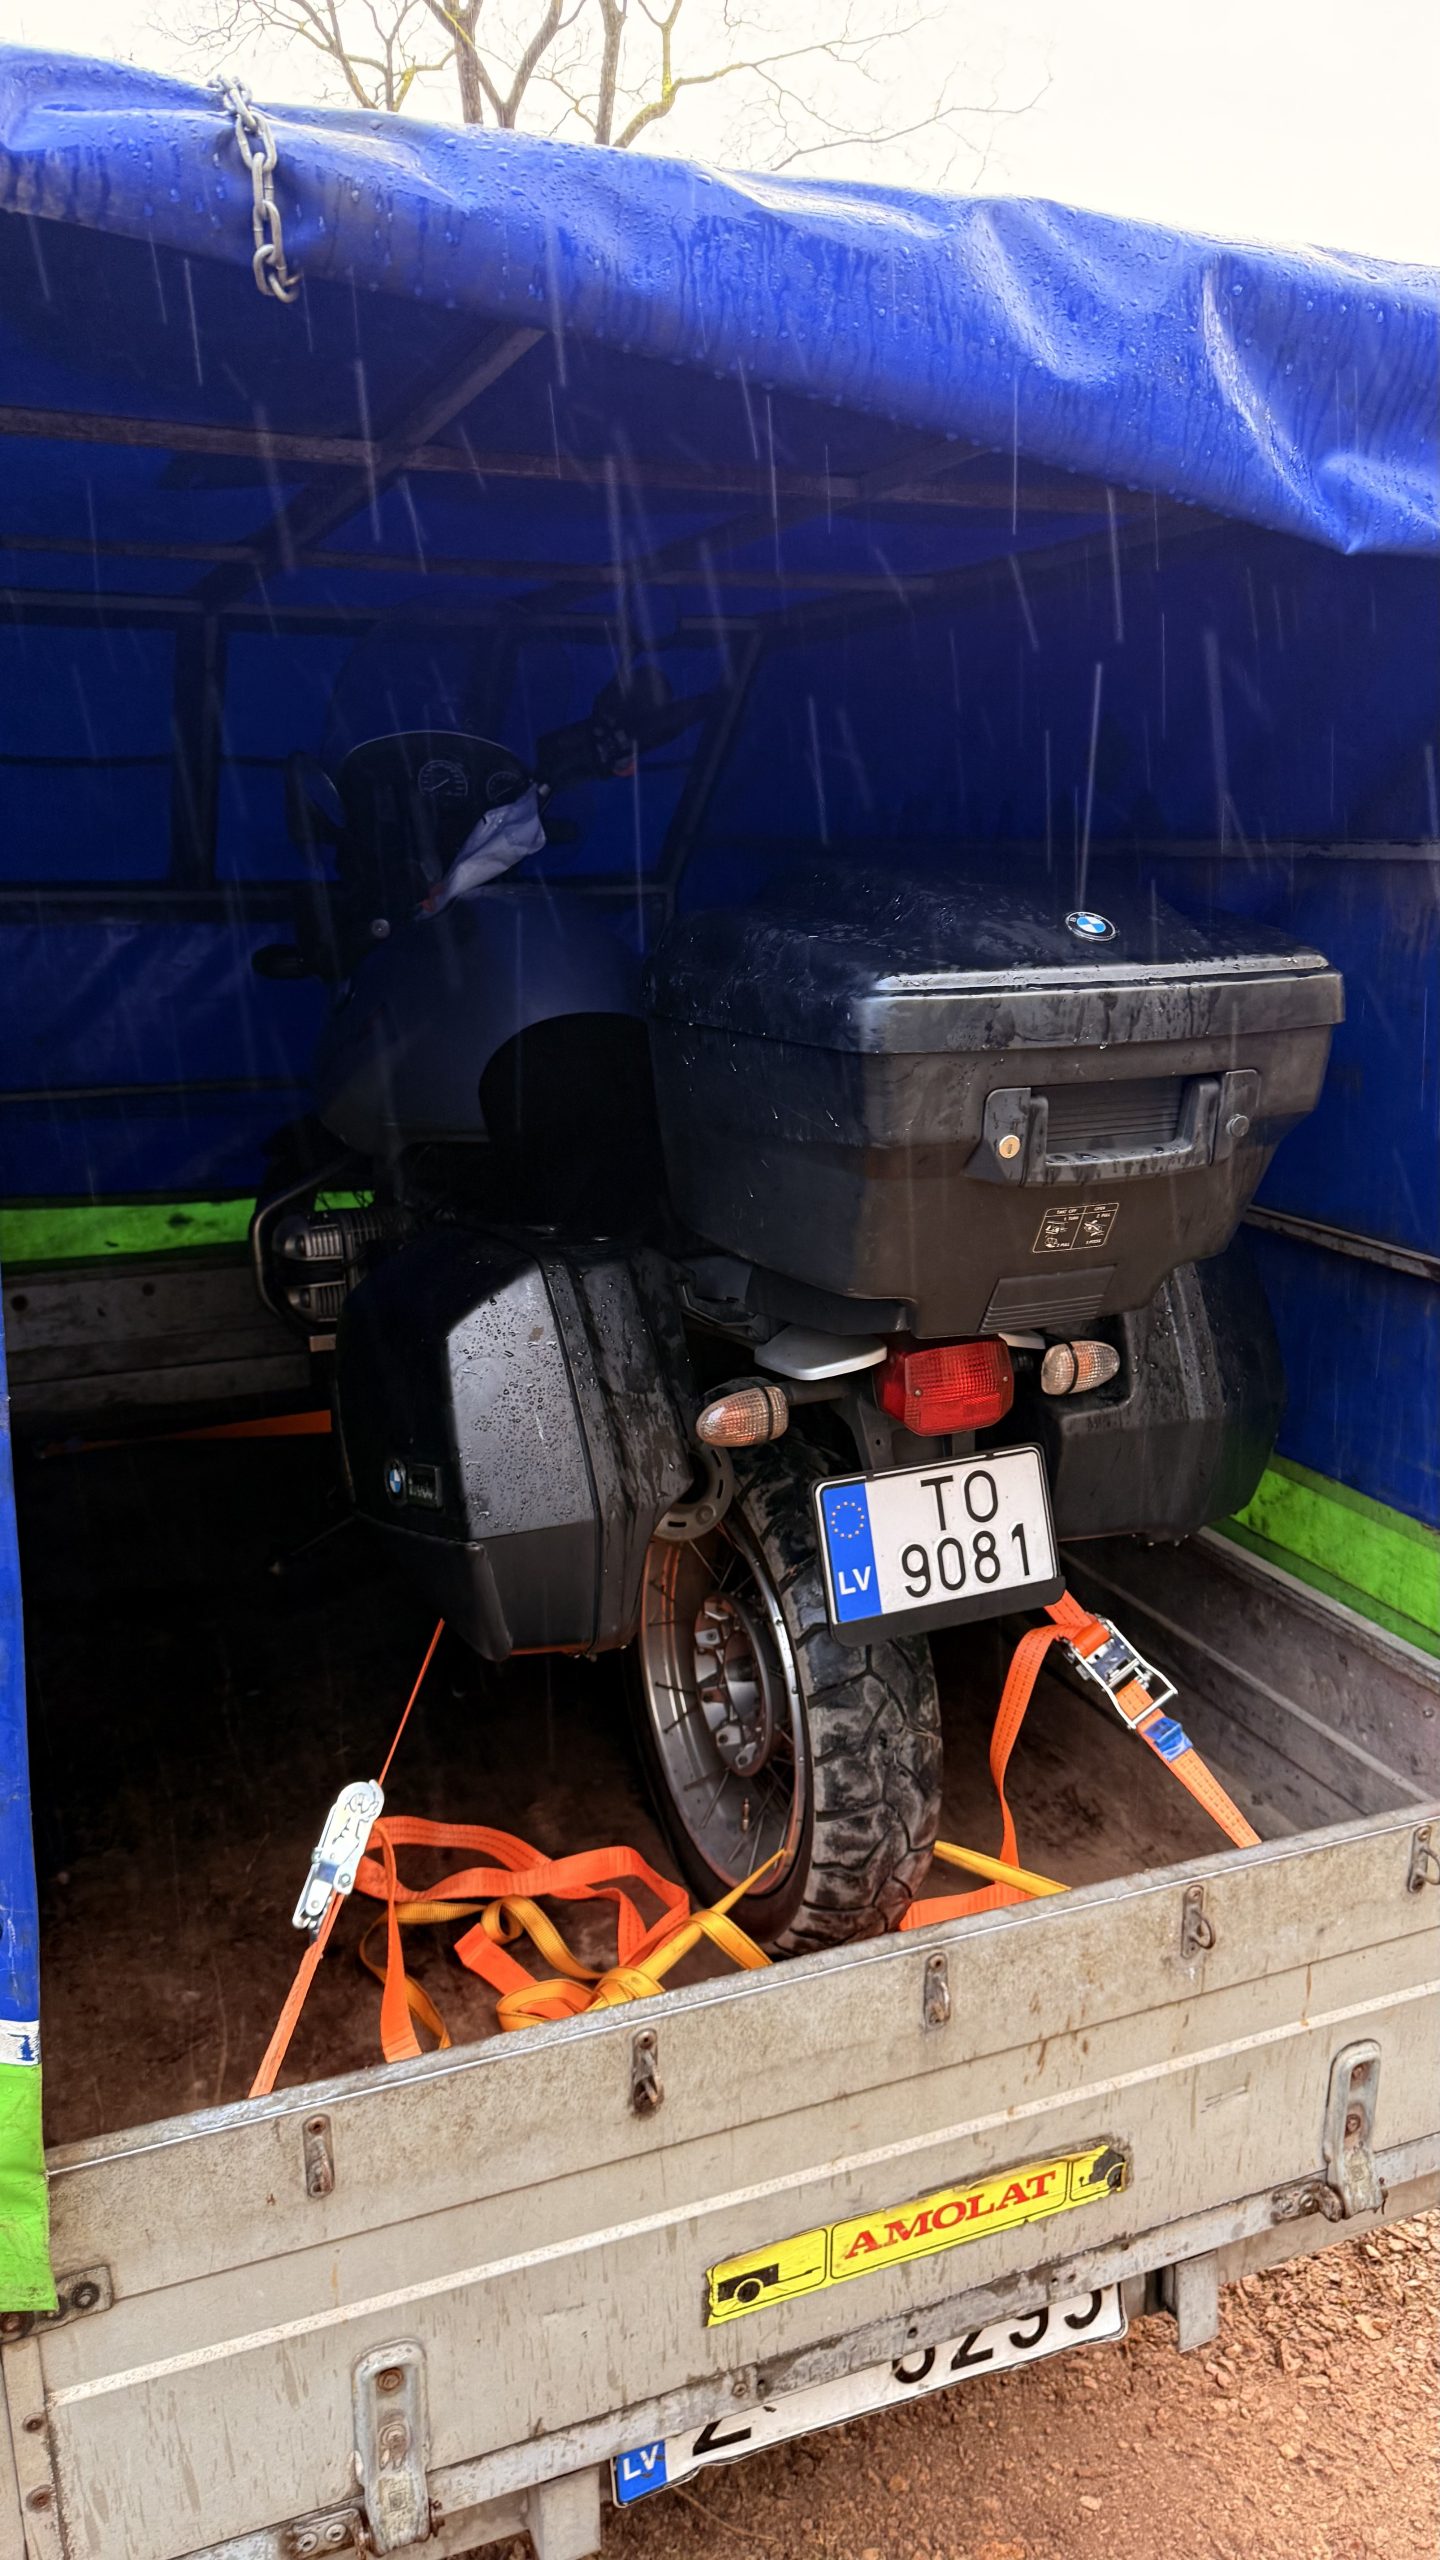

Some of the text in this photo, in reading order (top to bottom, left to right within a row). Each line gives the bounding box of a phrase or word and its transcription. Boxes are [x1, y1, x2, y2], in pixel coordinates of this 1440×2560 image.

[920, 1469, 999, 1531] TO
[838, 1565, 871, 1595] LV
[901, 1522, 1031, 1598] 9081
[844, 2170, 1056, 2260] AMOLAT
[623, 2444, 660, 2481] LV
